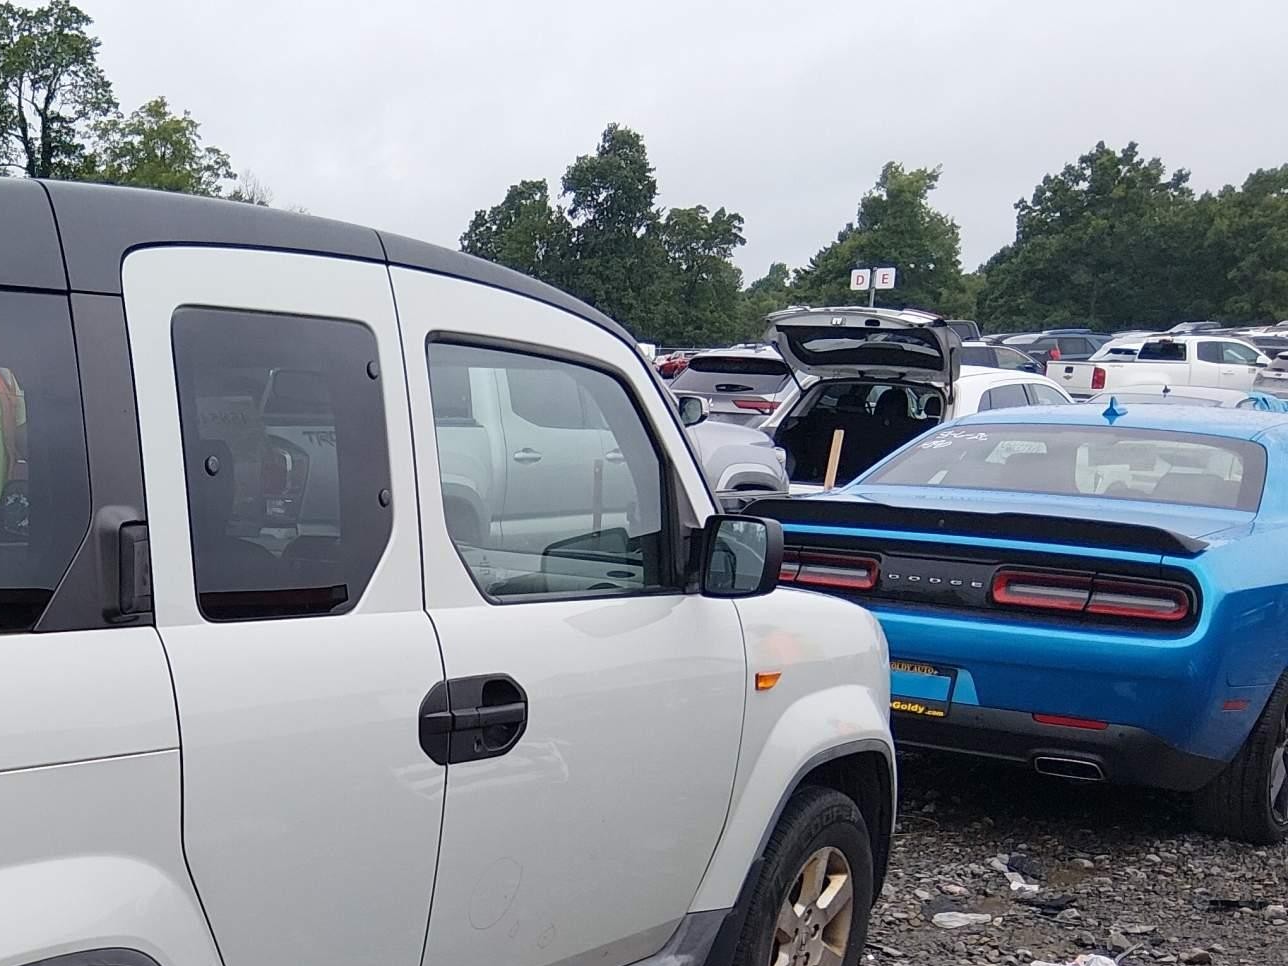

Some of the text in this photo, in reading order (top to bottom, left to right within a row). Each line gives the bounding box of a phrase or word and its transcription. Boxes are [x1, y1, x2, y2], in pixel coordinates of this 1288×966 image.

[856, 275, 865, 286] D
[882, 274, 889, 284] E
[888, 573, 984, 588] DODGE
[889, 662, 912, 673] OLDY
